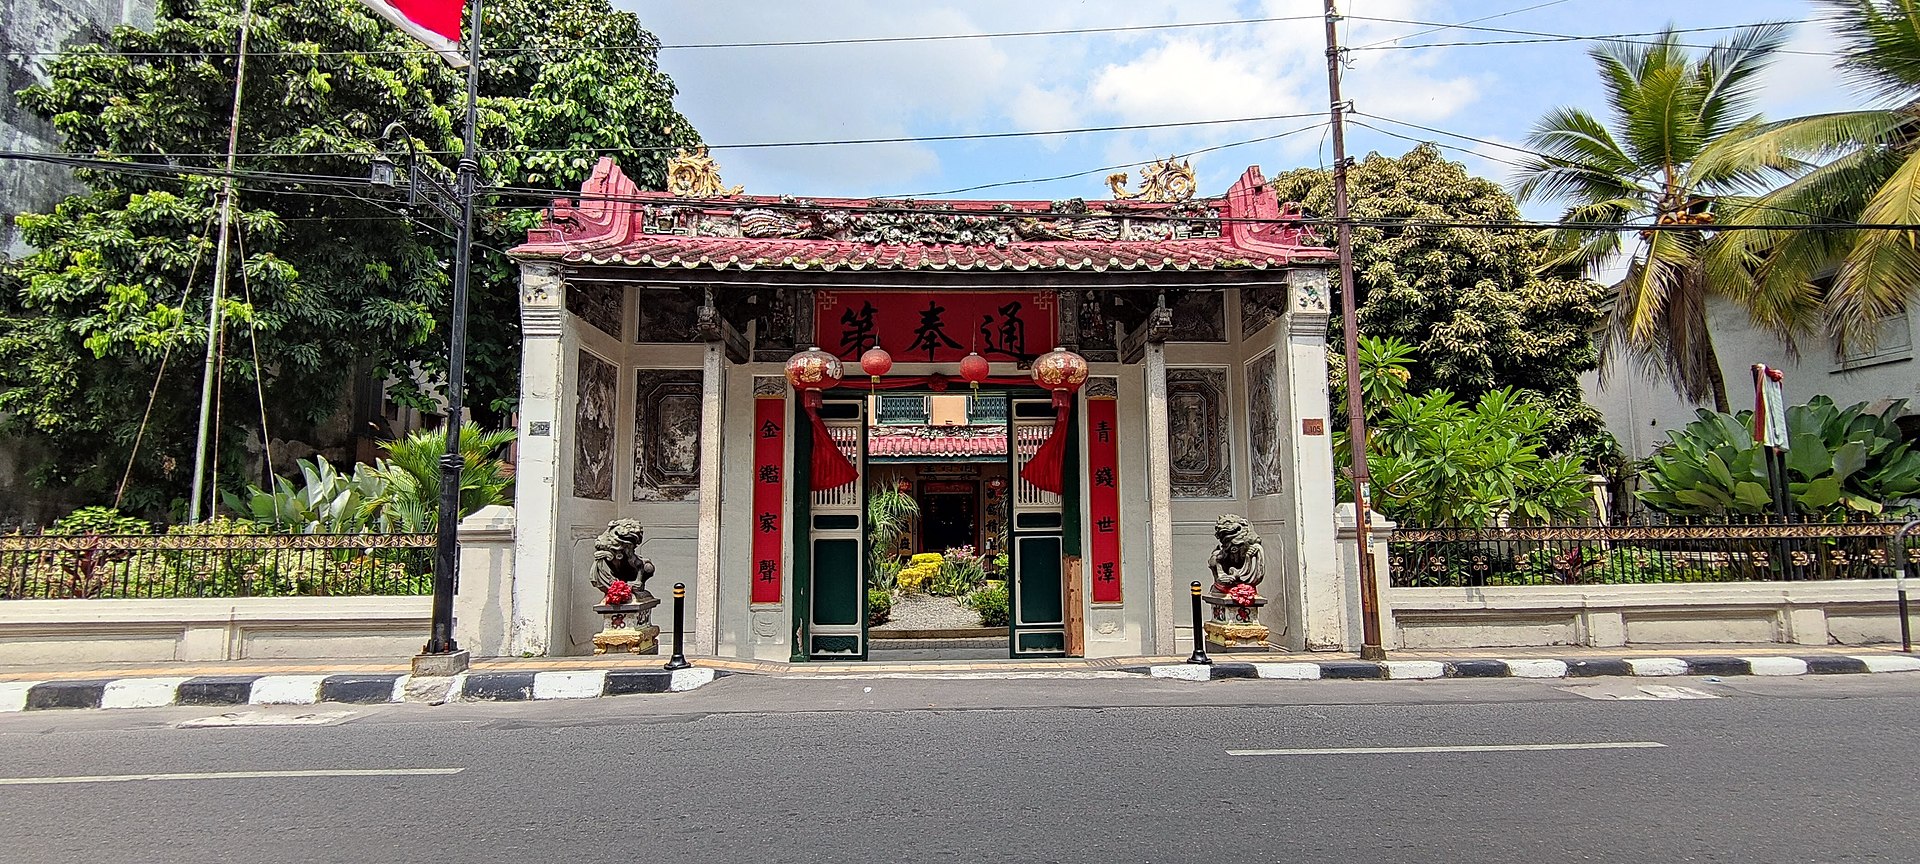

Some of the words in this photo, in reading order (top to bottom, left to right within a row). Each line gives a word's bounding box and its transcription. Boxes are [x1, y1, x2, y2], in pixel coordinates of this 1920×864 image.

[1310, 425, 1322, 433] 105
[1094, 420, 1116, 584] 青錢世澤
